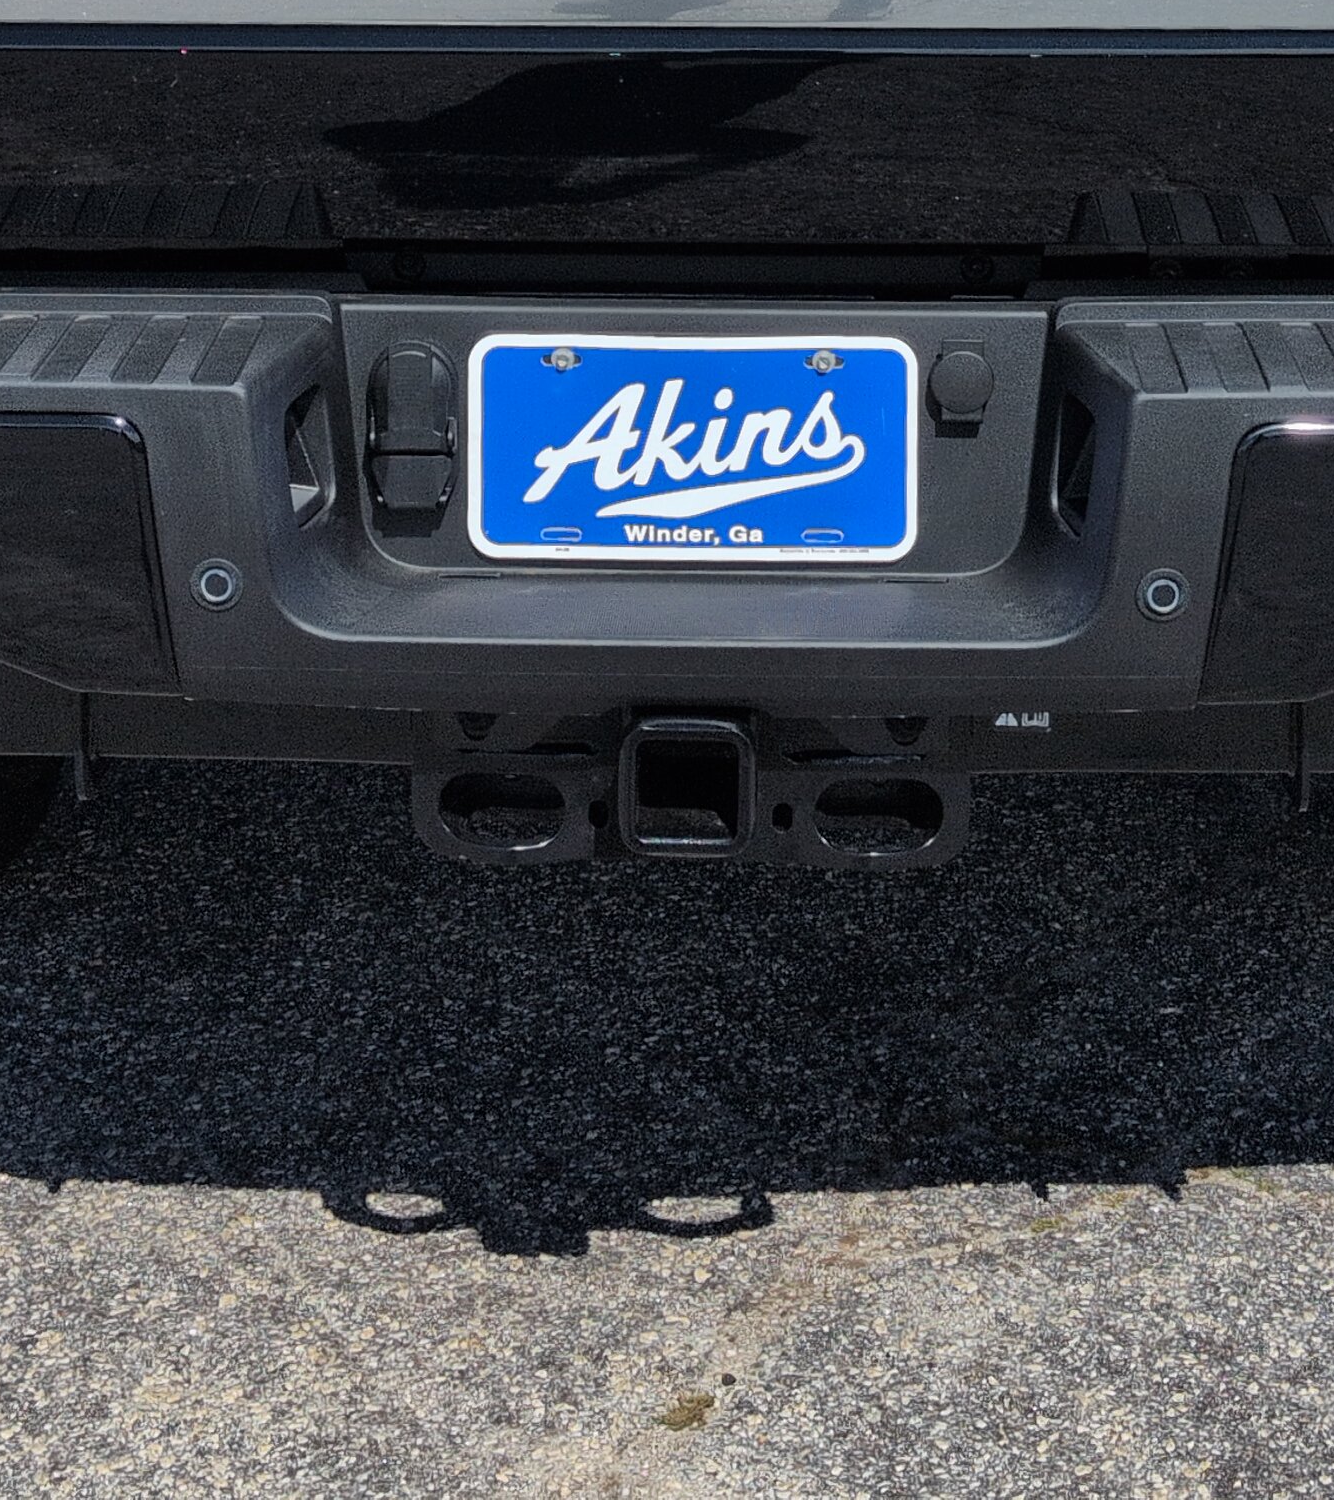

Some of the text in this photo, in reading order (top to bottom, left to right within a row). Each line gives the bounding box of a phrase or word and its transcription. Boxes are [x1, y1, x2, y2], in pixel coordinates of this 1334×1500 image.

[522, 378, 866, 518] Akins
[623, 523, 765, 546] Winder, Ga
